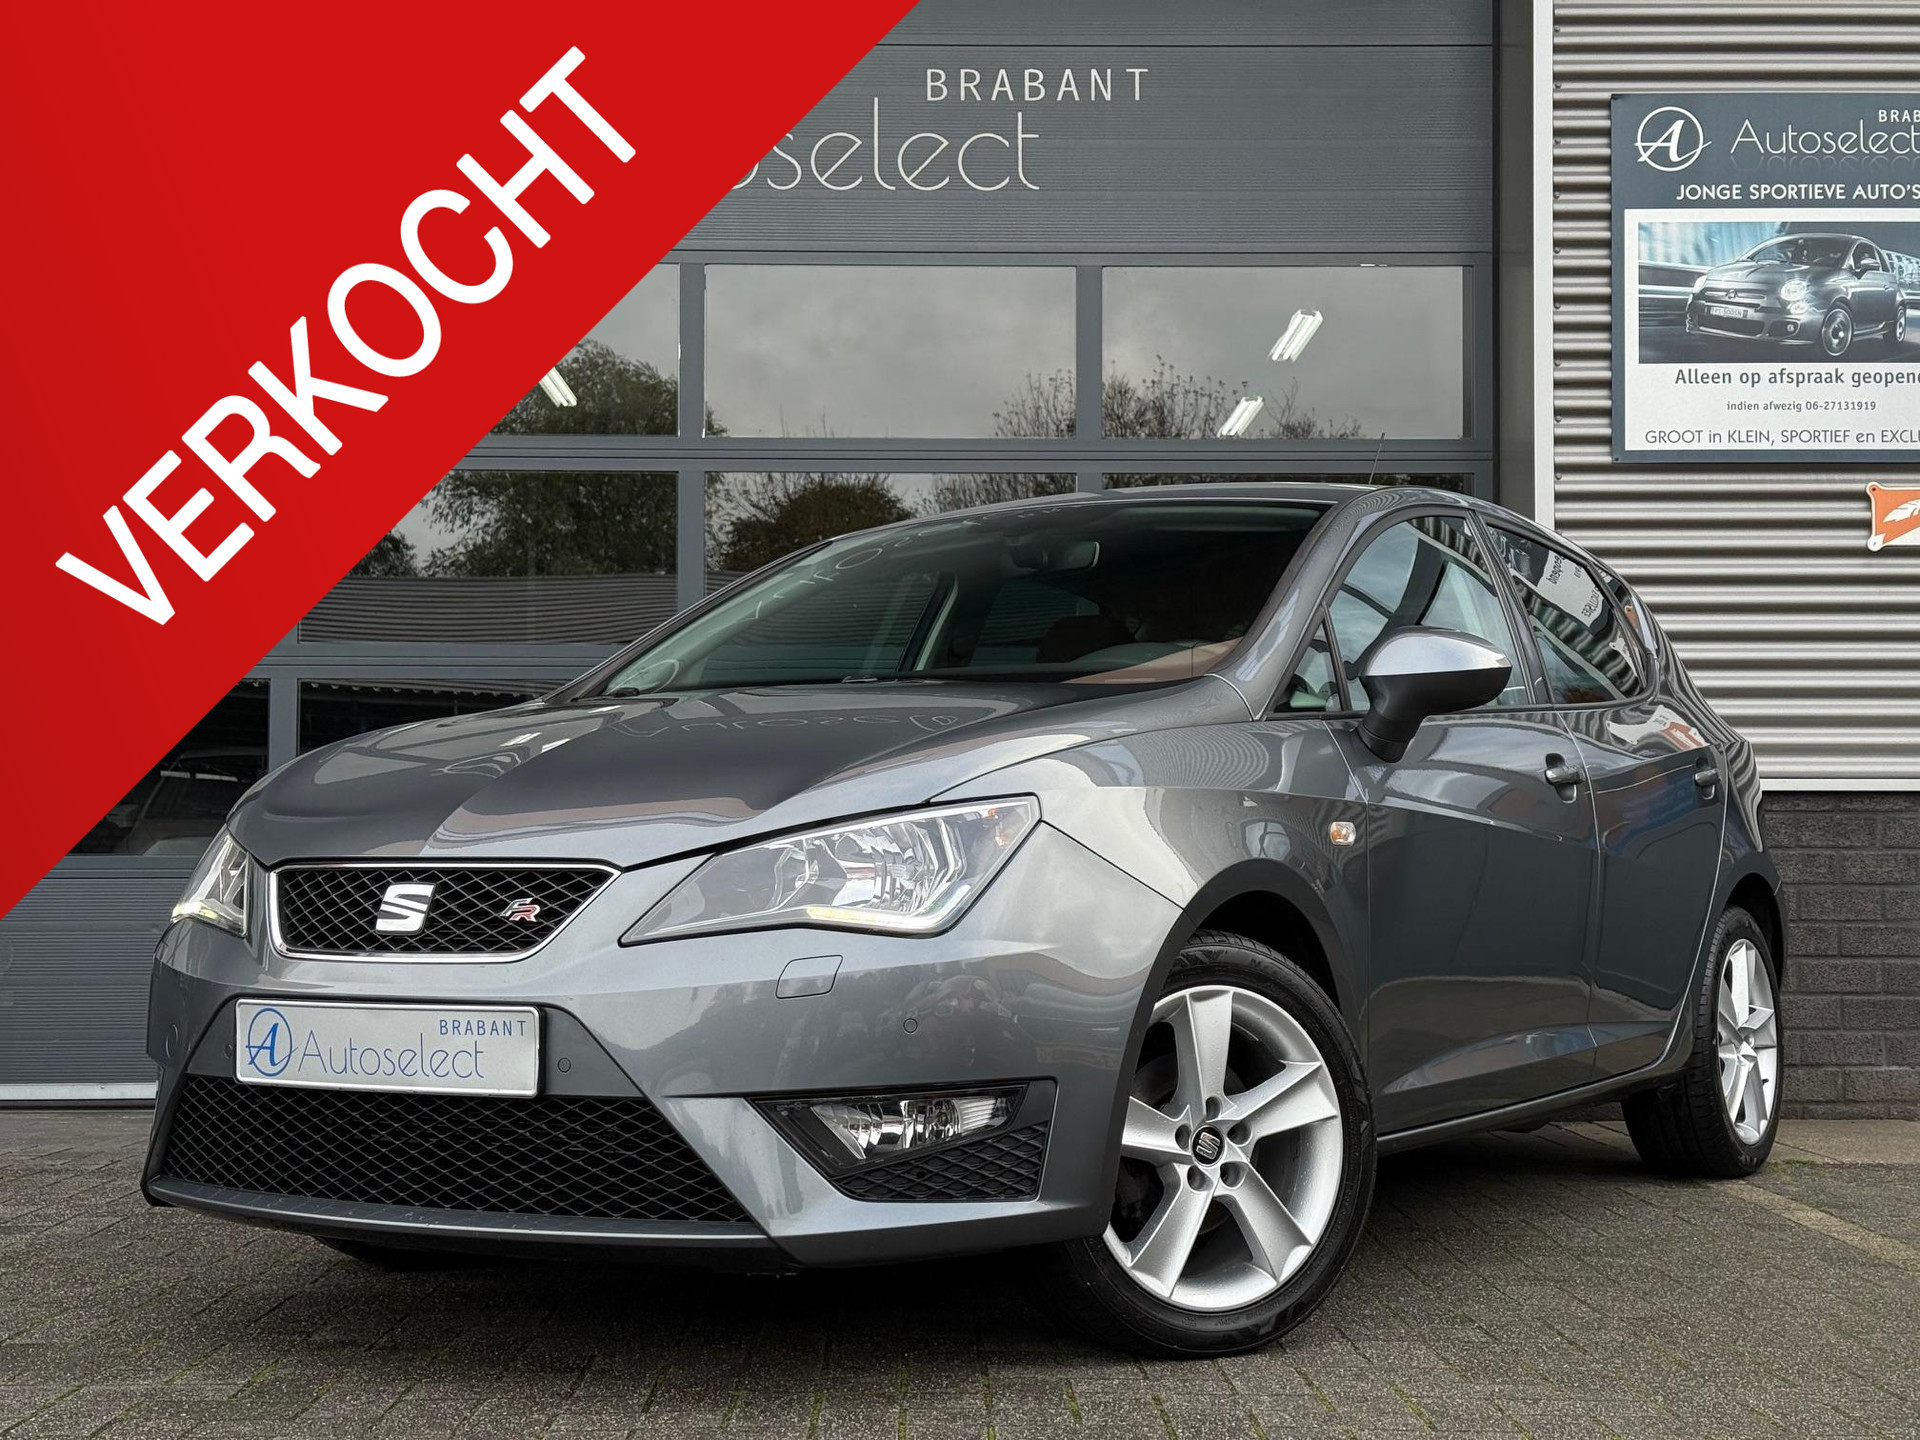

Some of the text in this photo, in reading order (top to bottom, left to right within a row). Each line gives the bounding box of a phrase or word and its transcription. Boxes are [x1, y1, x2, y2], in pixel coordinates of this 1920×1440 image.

[926, 68, 1150, 101] BRABANT
[1730, 119, 1920, 155] Autoselect
[1676, 184, 1743, 200] JONGE
[1749, 184, 1846, 200] SPORTIEVE
[1675, 367, 1920, 389] Alleen op afspraak geopen
[1726, 400, 1877, 413] indien afwezig 06-27131919
[1645, 429, 1920, 446] GROOT in KLEIN, SPORTIEF en EXCL
[438, 1018, 527, 1037] BRABANT
[297, 1029, 485, 1079] Autoselect
